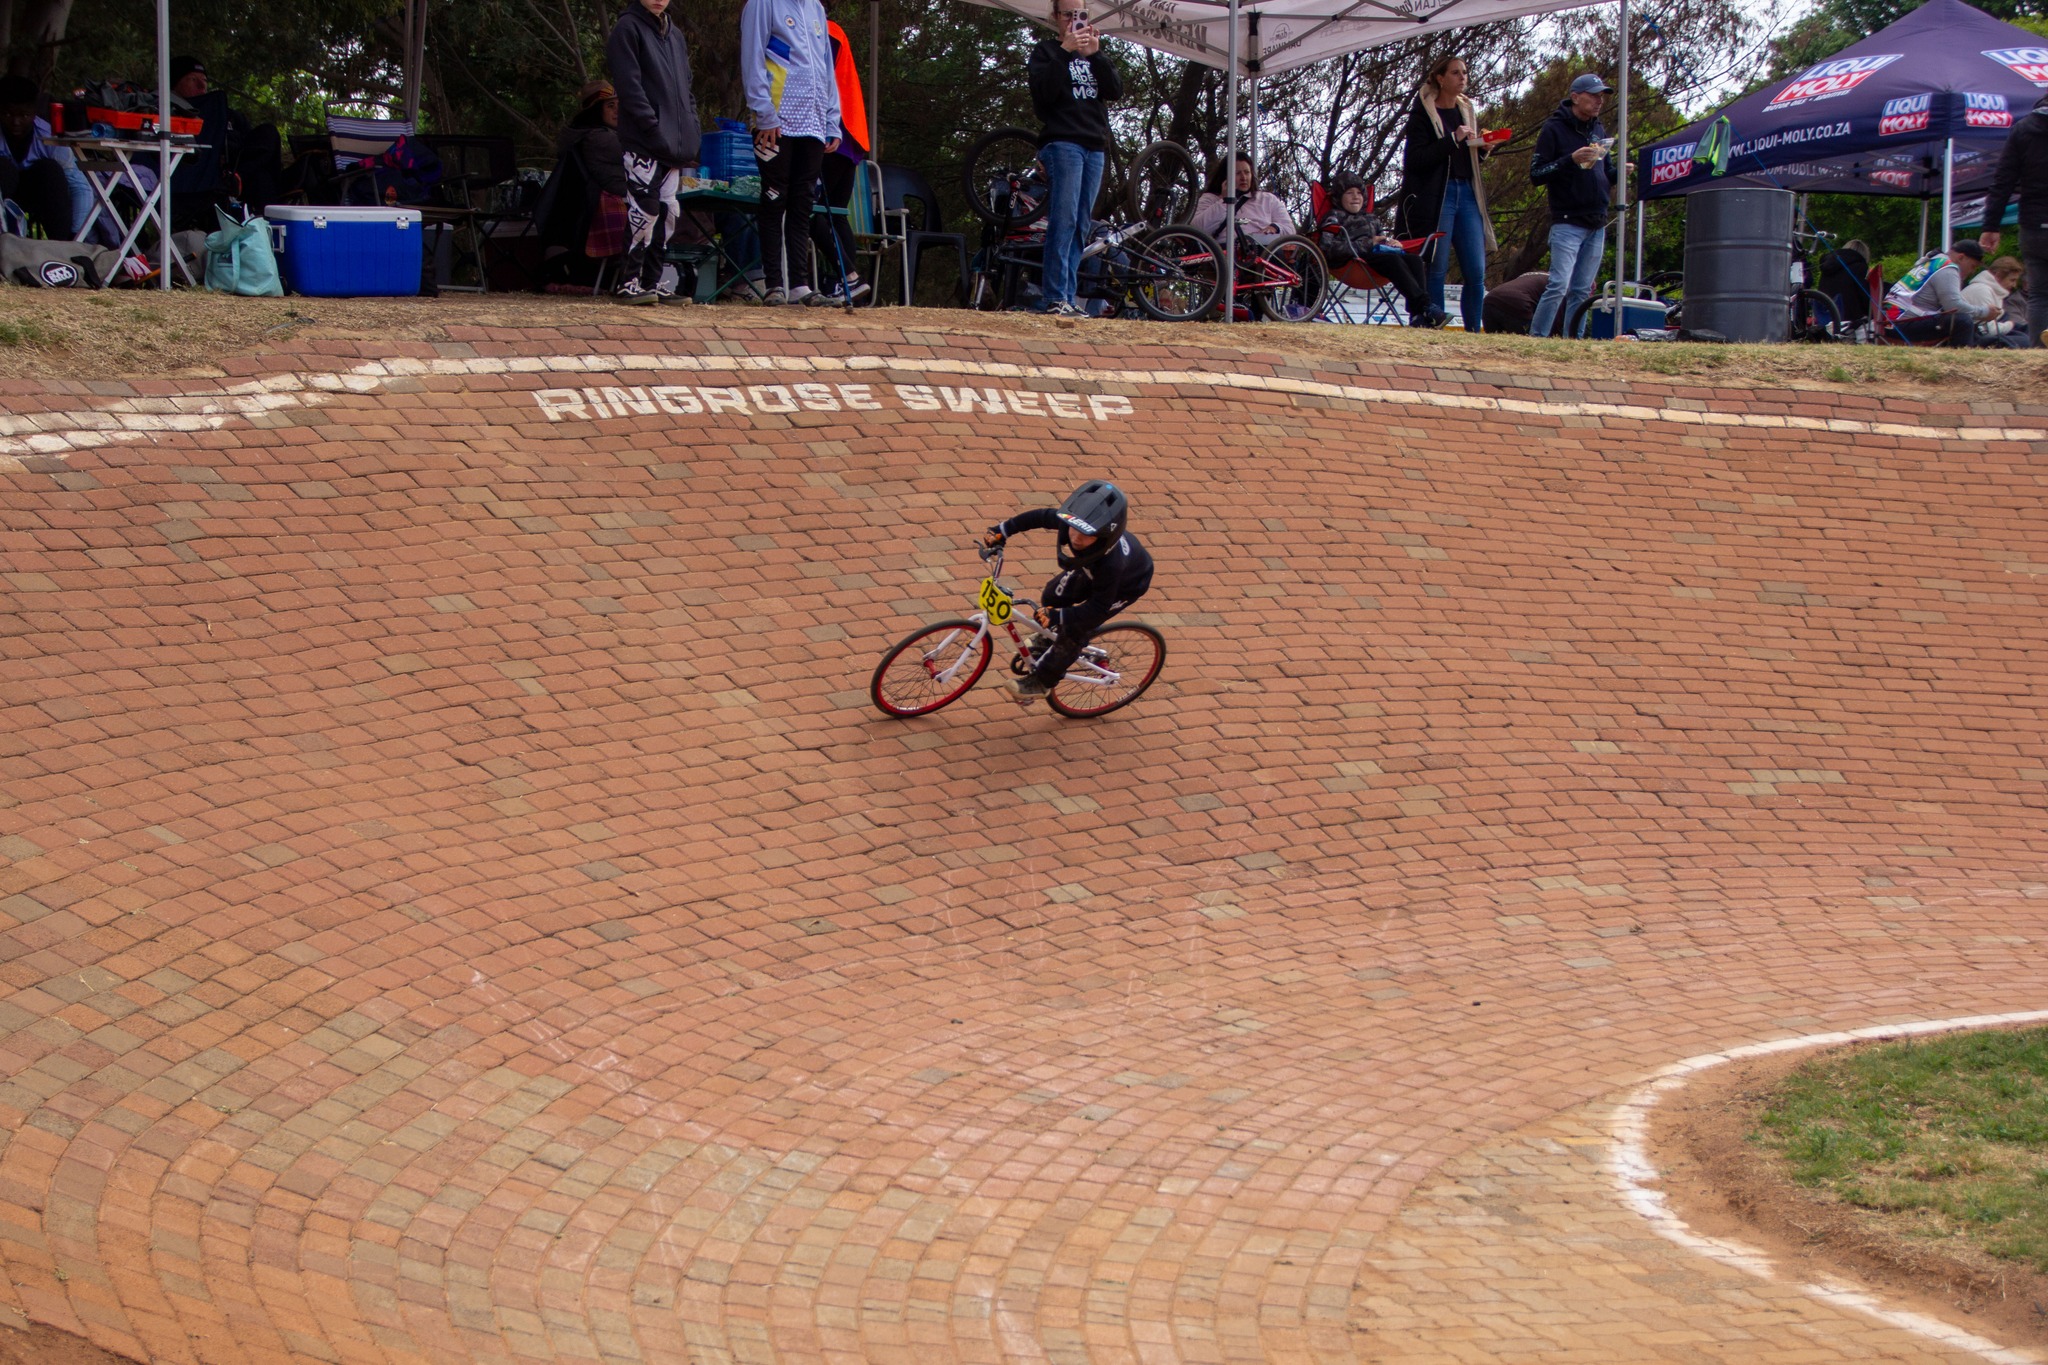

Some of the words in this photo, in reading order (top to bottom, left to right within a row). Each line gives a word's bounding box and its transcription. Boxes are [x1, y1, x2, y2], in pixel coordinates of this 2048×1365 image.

[1992, 49, 2048, 65] LIQ
[1801, 55, 1897, 82] LIQUI
[1776, 69, 1874, 101] MOLY
[1885, 95, 1930, 116] LIQUI
[1967, 94, 2006, 111] LIQUI
[1881, 113, 1928, 134] MOLY
[1966, 111, 2009, 126] MOLY
[1728, 121, 1851, 159] W.LIQUI-MOLY.CO.ZA
[1654, 144, 1696, 166] LIQUI
[1652, 159, 1693, 183] MOLY
[530, 383, 885, 422] RINGROSE
[894, 384, 1135, 421] SWEEP
[1068, 516, 1097, 533] LEATT
[981, 580, 1011, 620] 150
